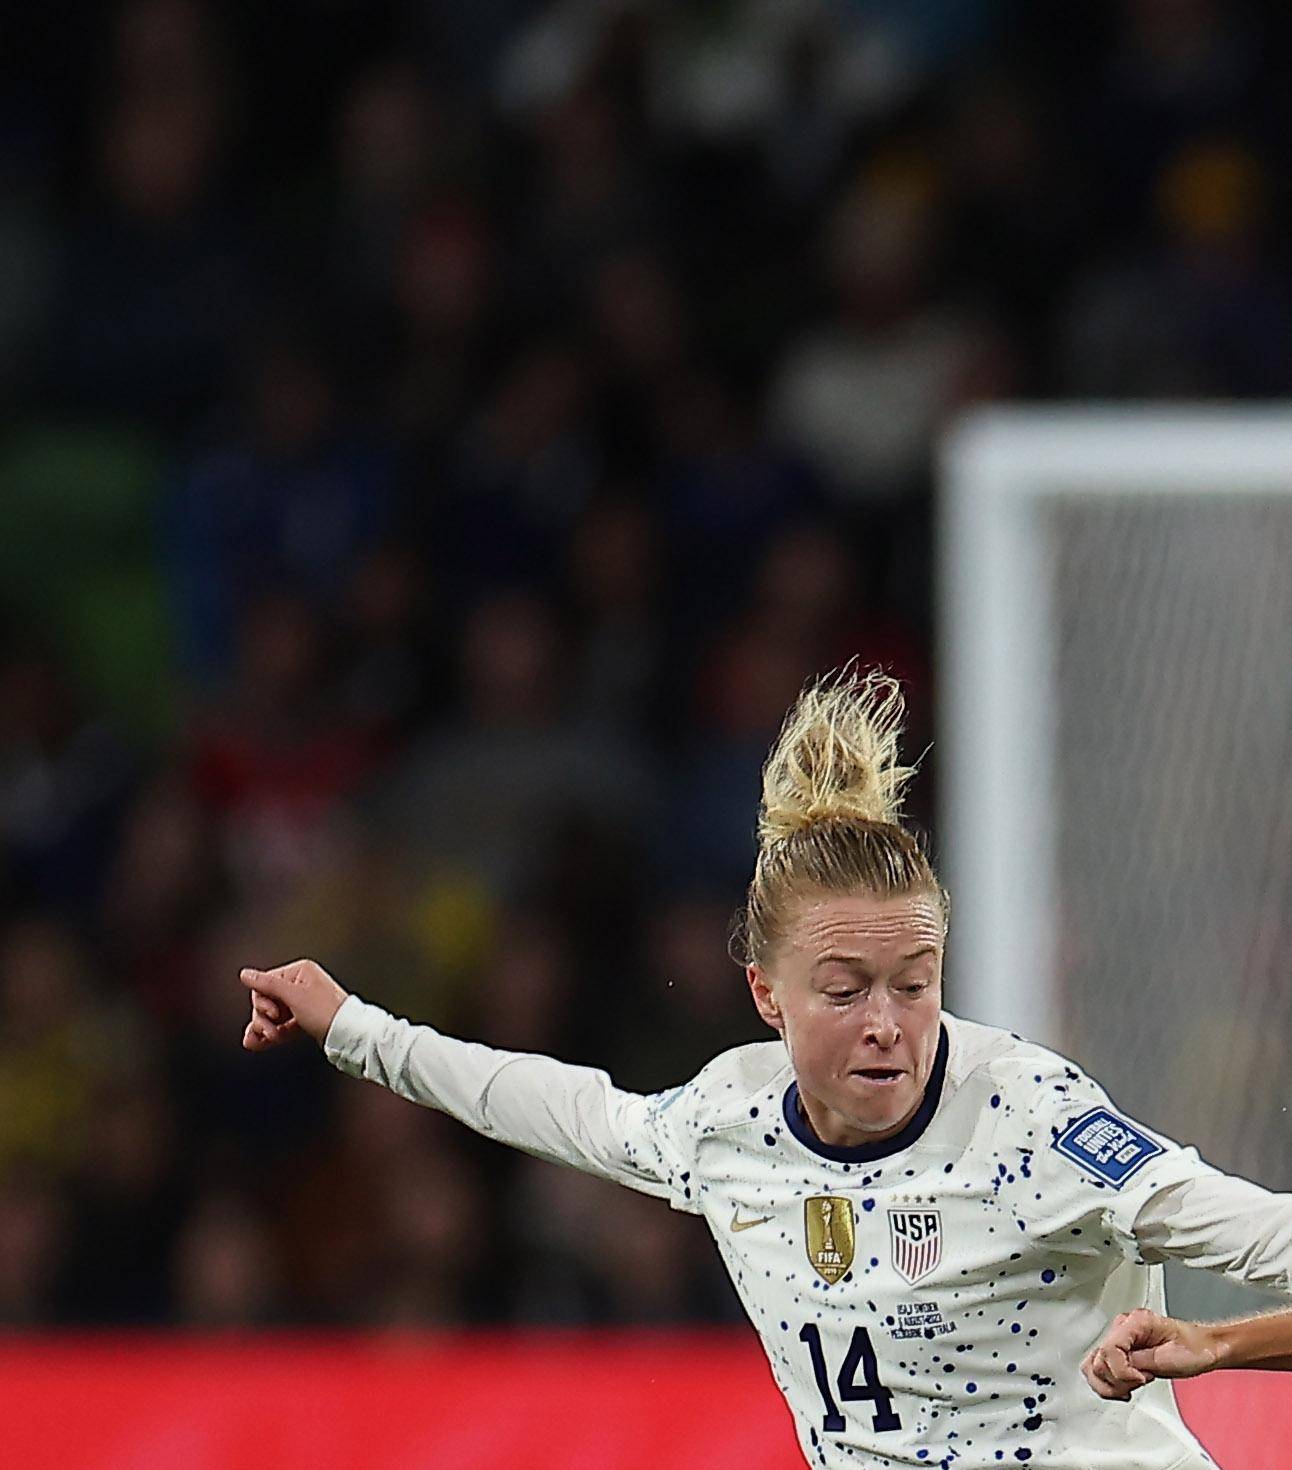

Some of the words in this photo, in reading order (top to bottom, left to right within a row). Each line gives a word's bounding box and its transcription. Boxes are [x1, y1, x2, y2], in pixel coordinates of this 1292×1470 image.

[893, 1214, 937, 1241] USA
[817, 1252, 842, 1264] FIFA
[799, 1323, 902, 1433] 14
